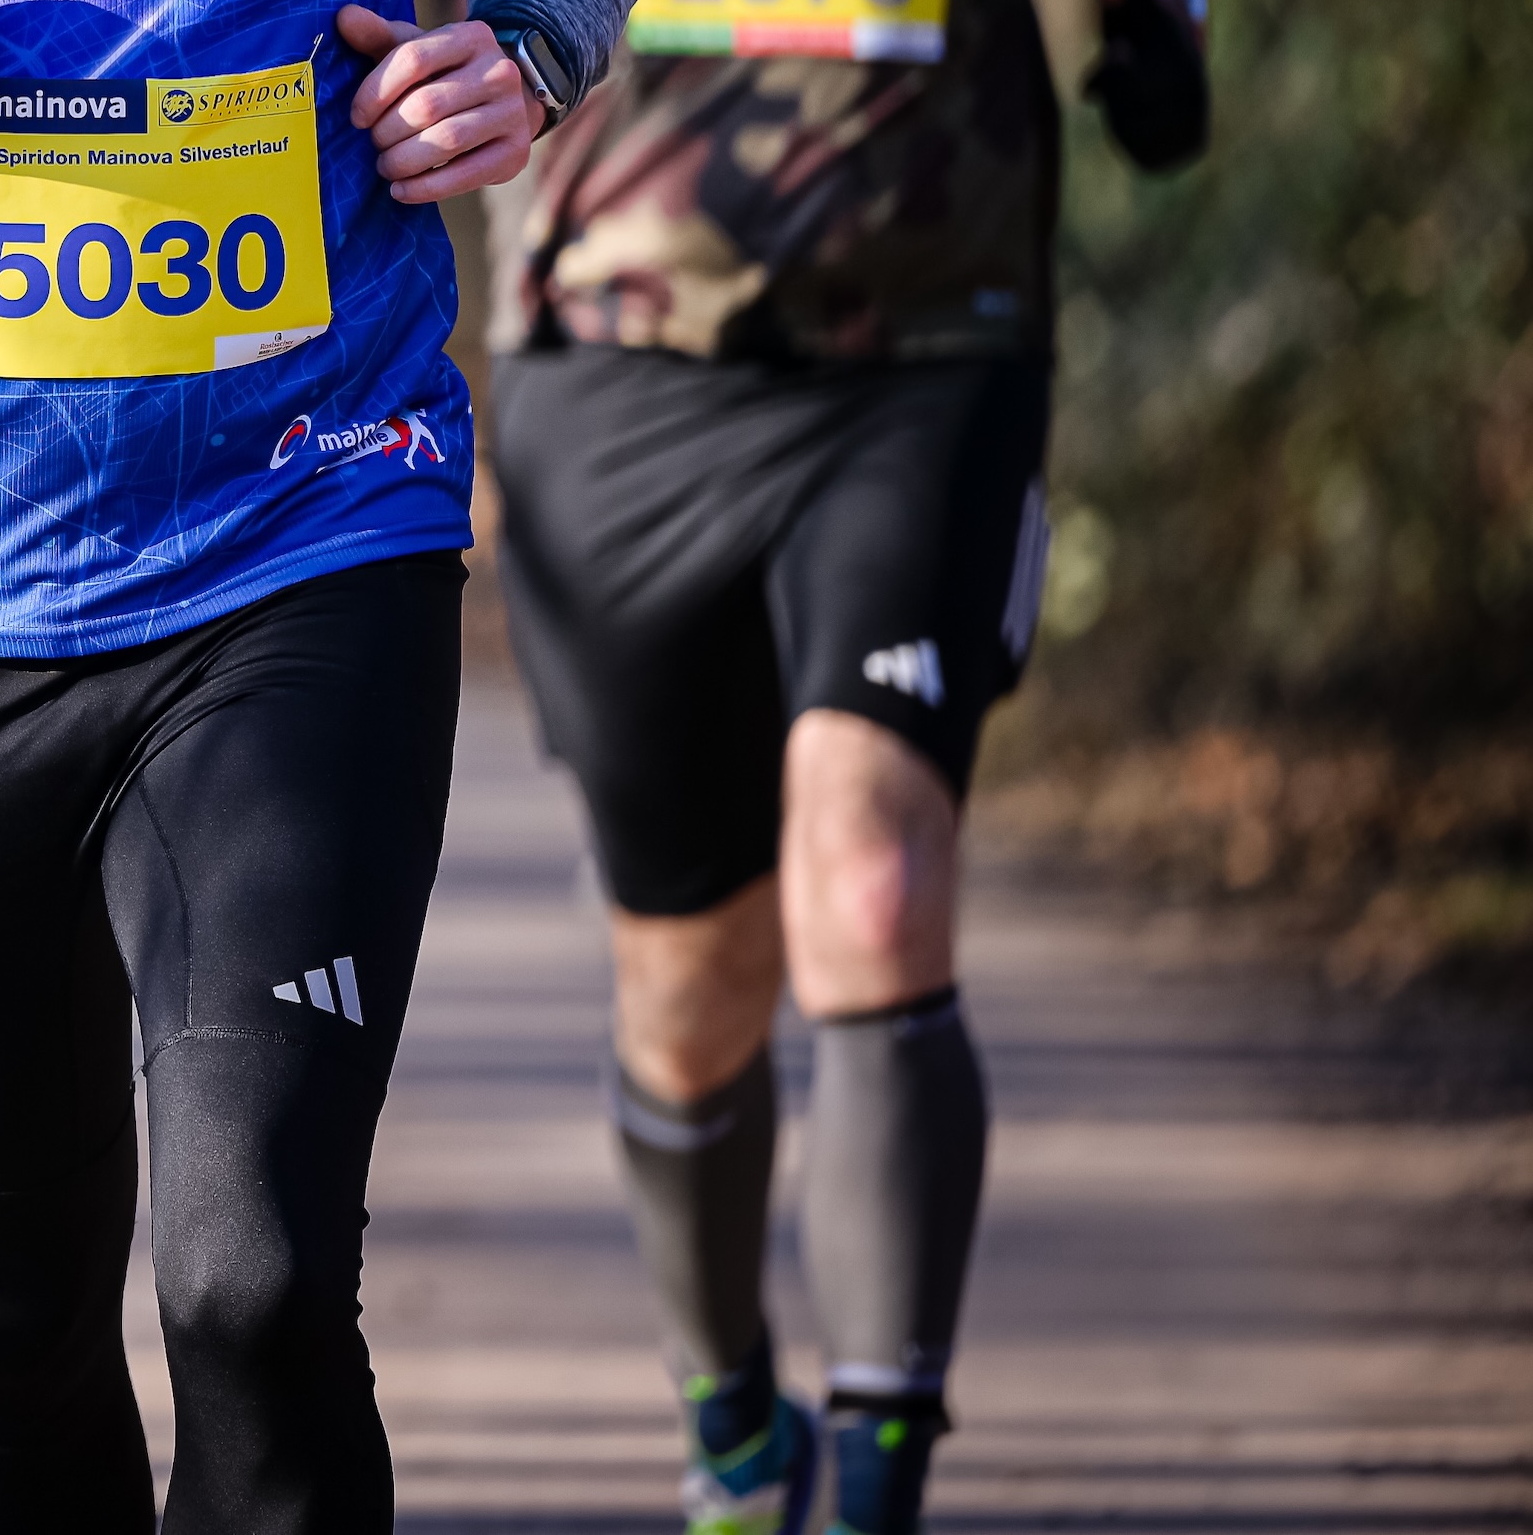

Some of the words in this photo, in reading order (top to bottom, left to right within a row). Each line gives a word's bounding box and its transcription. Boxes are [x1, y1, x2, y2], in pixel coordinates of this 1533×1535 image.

[198, 80, 305, 111] SPIRIDON
[88, 150, 173, 165] Mainova
[180, 136, 289, 163] Silvesterlauf
